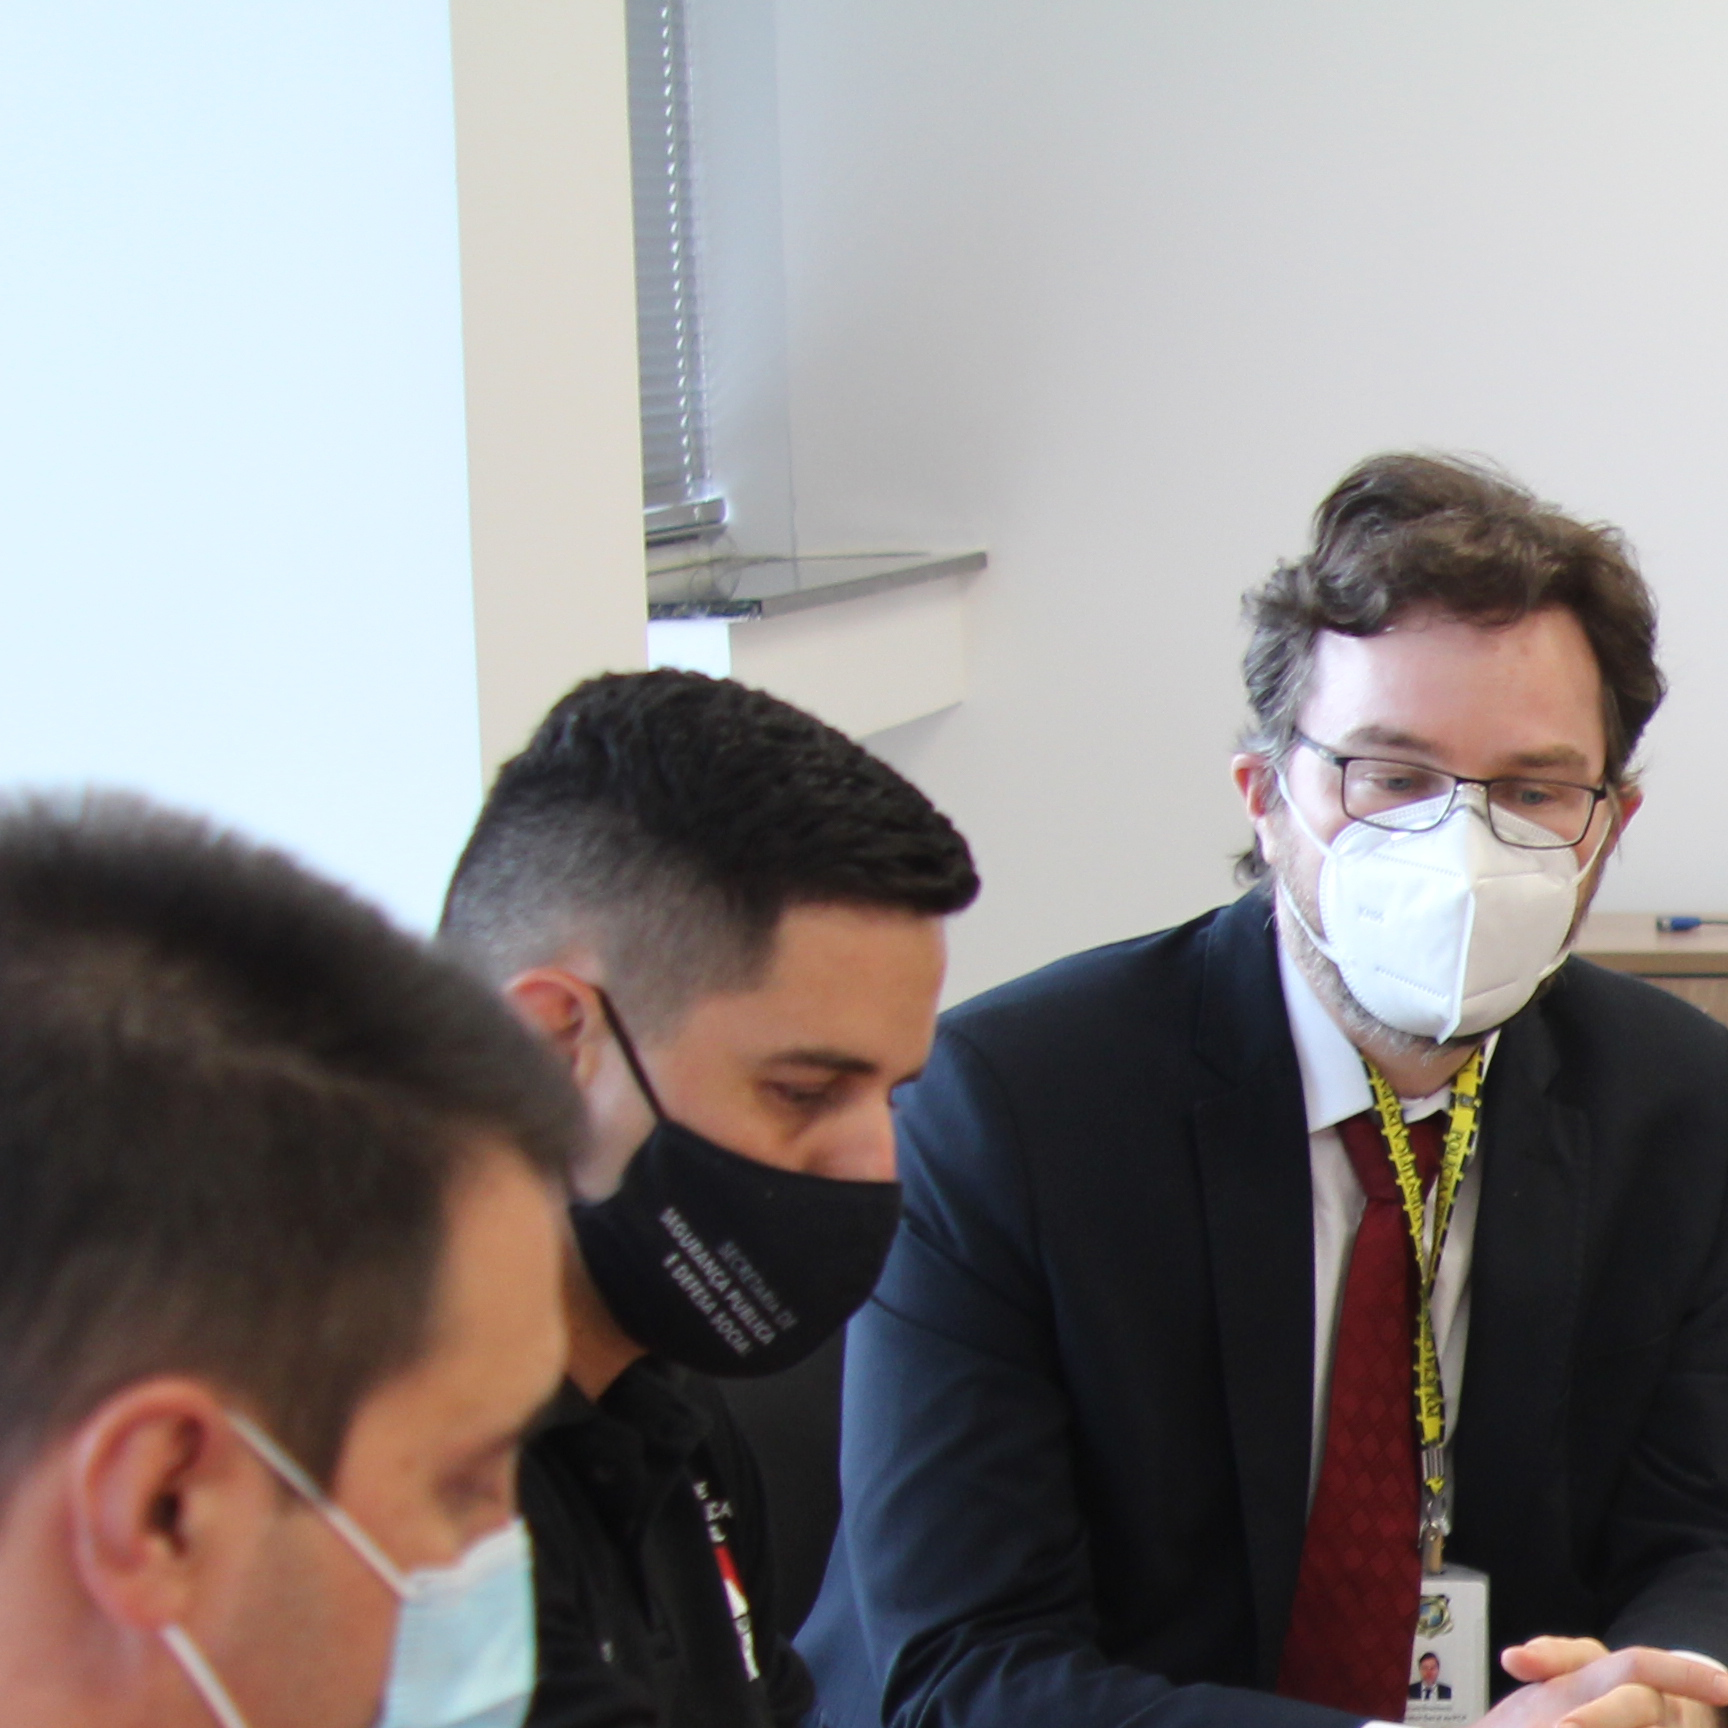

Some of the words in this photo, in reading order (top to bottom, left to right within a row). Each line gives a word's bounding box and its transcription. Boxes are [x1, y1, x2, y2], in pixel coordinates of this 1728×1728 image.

[658, 1206, 731, 1292] SEGURANÇA
[671, 1263, 718, 1314] DEFESA
[717, 1240, 781, 1313] SECRETARIA
[775, 1309, 798, 1332] DE
